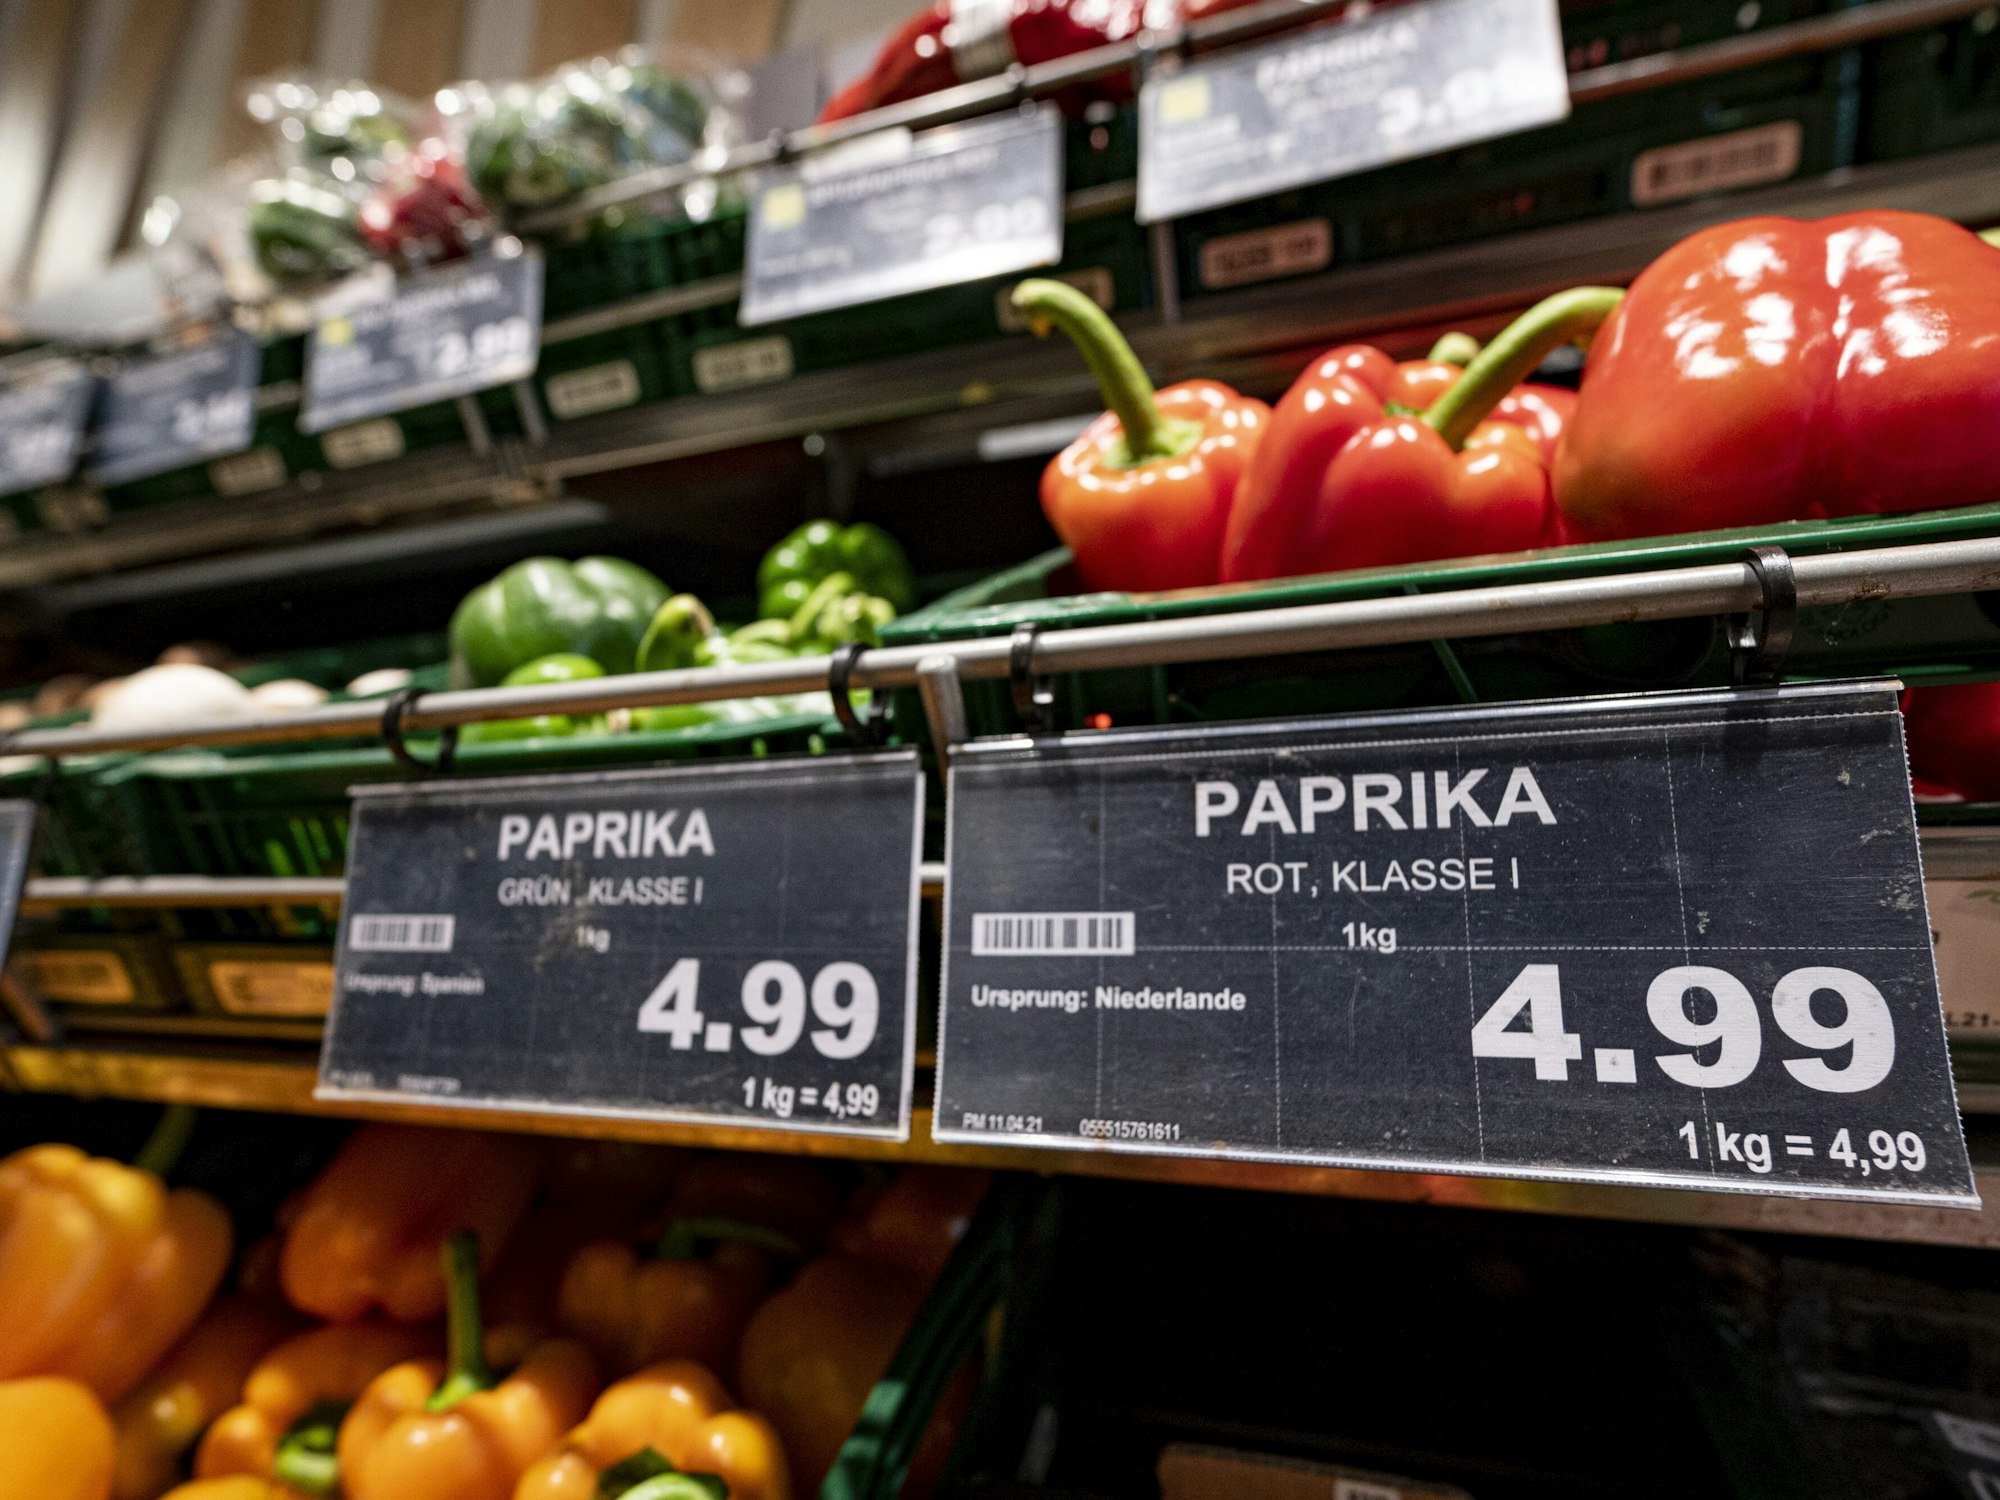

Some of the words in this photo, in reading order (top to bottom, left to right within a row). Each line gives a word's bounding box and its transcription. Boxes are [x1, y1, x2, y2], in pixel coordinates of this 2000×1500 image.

[1195, 766, 1558, 837] PAPRIKA
[497, 808, 715, 862] PAPRIKA
[587, 875, 689, 906] KLASSE
[693, 877, 704, 905] I
[1226, 862, 1318, 898] ROT,
[1331, 858, 1496, 893] KLASSE
[1511, 857, 1520, 889] I
[1342, 922, 1398, 954] 1kg
[636, 958, 880, 1060] 4.99
[970, 984, 1089, 1014] Ursprung:
[1095, 986, 1247, 1011] Niederlande
[1471, 963, 1896, 1093] 4.99
[742, 1076, 757, 1109] 1
[762, 1077, 796, 1119] kg
[801, 1086, 819, 1105] =
[822, 1081, 880, 1120] 4,99
[1678, 1121, 1699, 1160] 1
[1716, 1122, 1773, 1174] kg
[1785, 1134, 1814, 1157] =
[1828, 1127, 1927, 1178] 4,99
